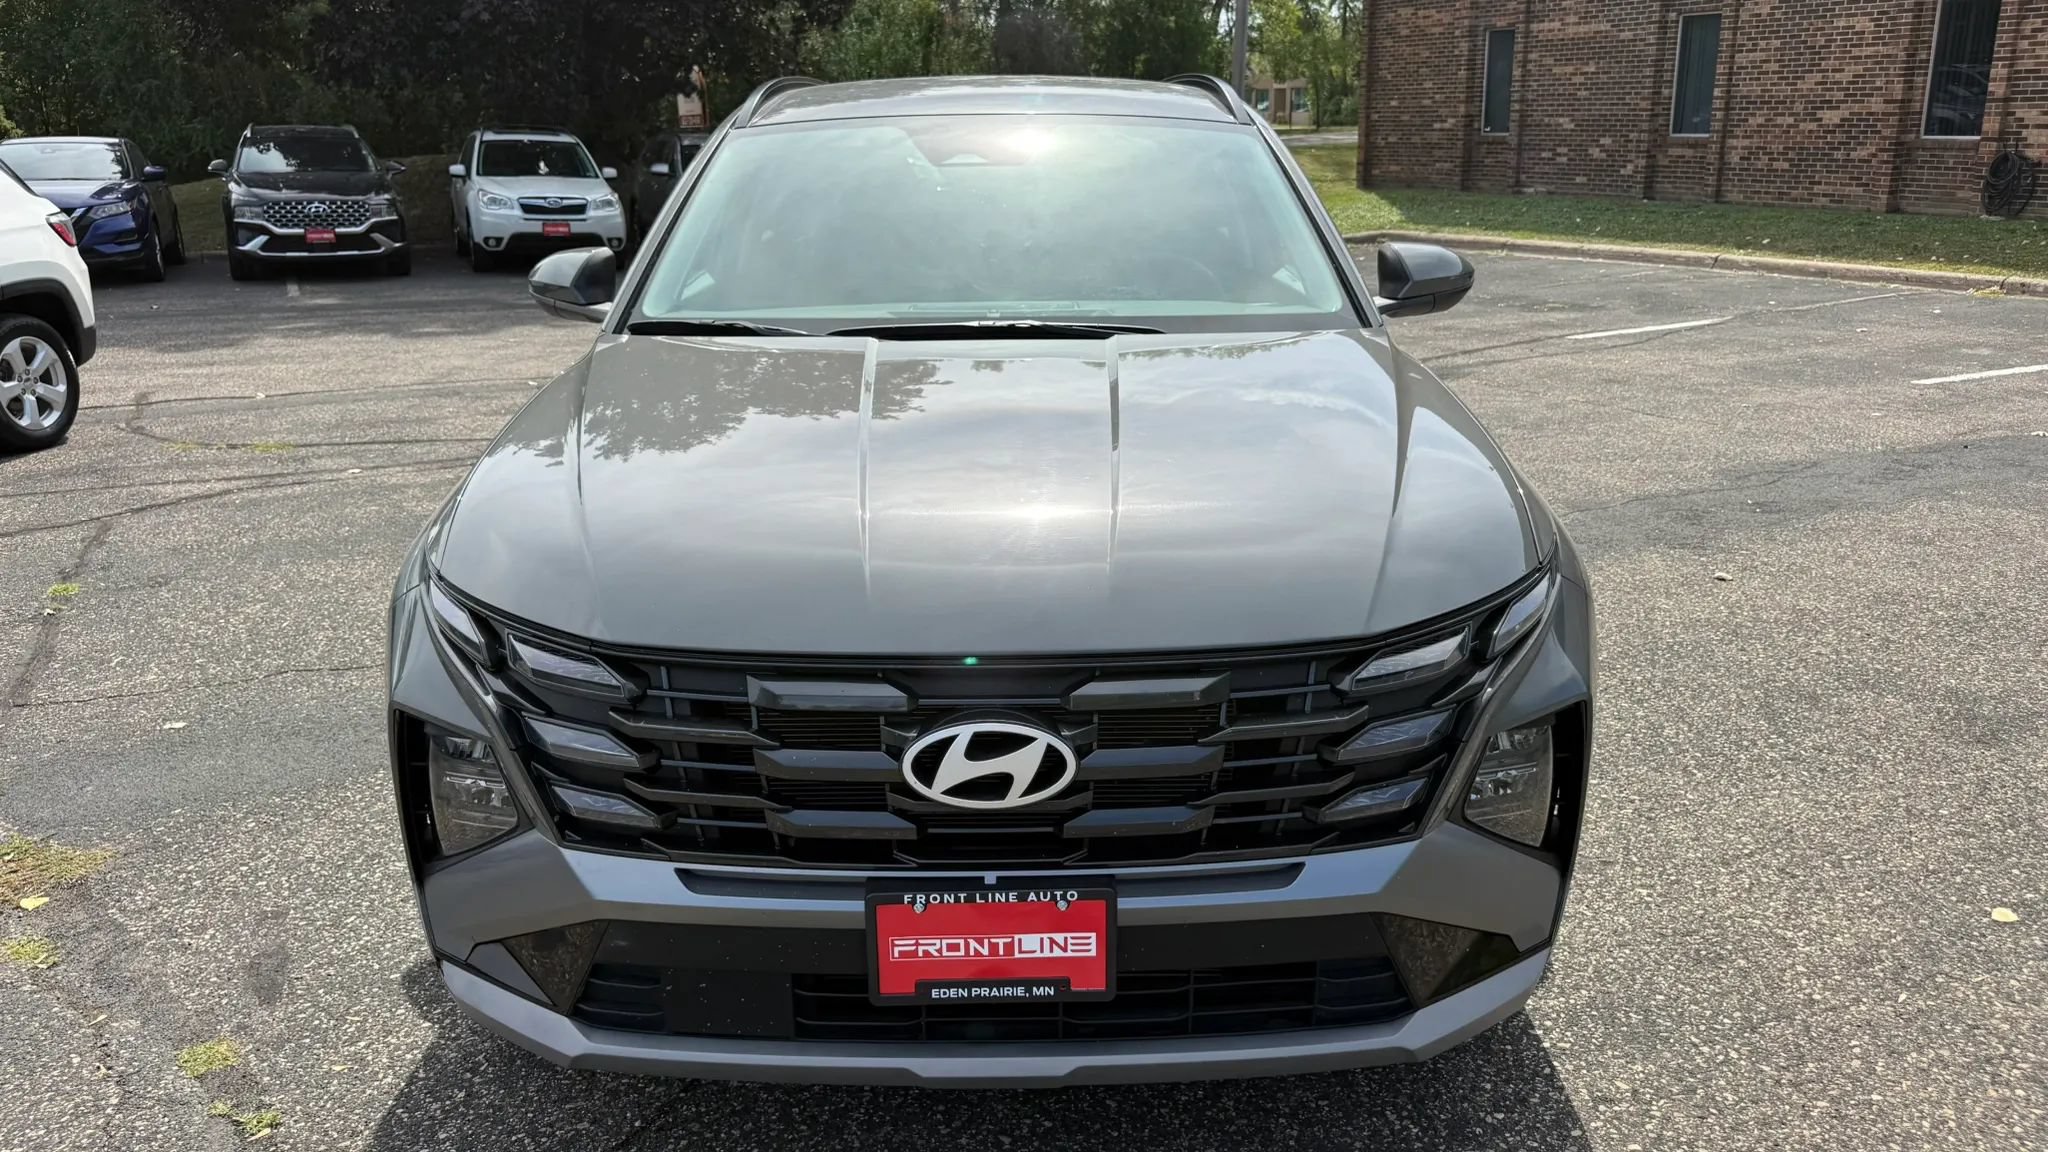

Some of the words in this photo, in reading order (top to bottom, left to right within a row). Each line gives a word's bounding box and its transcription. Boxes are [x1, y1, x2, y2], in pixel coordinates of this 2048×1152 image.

[904, 893, 967, 904] FRONT
[976, 892, 1018, 903] LINE
[1027, 891, 1078, 902] AUTO
[931, 988, 968, 998] EDEN
[972, 987, 1029, 998] PRAIRIE,
[1032, 986, 1054, 996] MN
